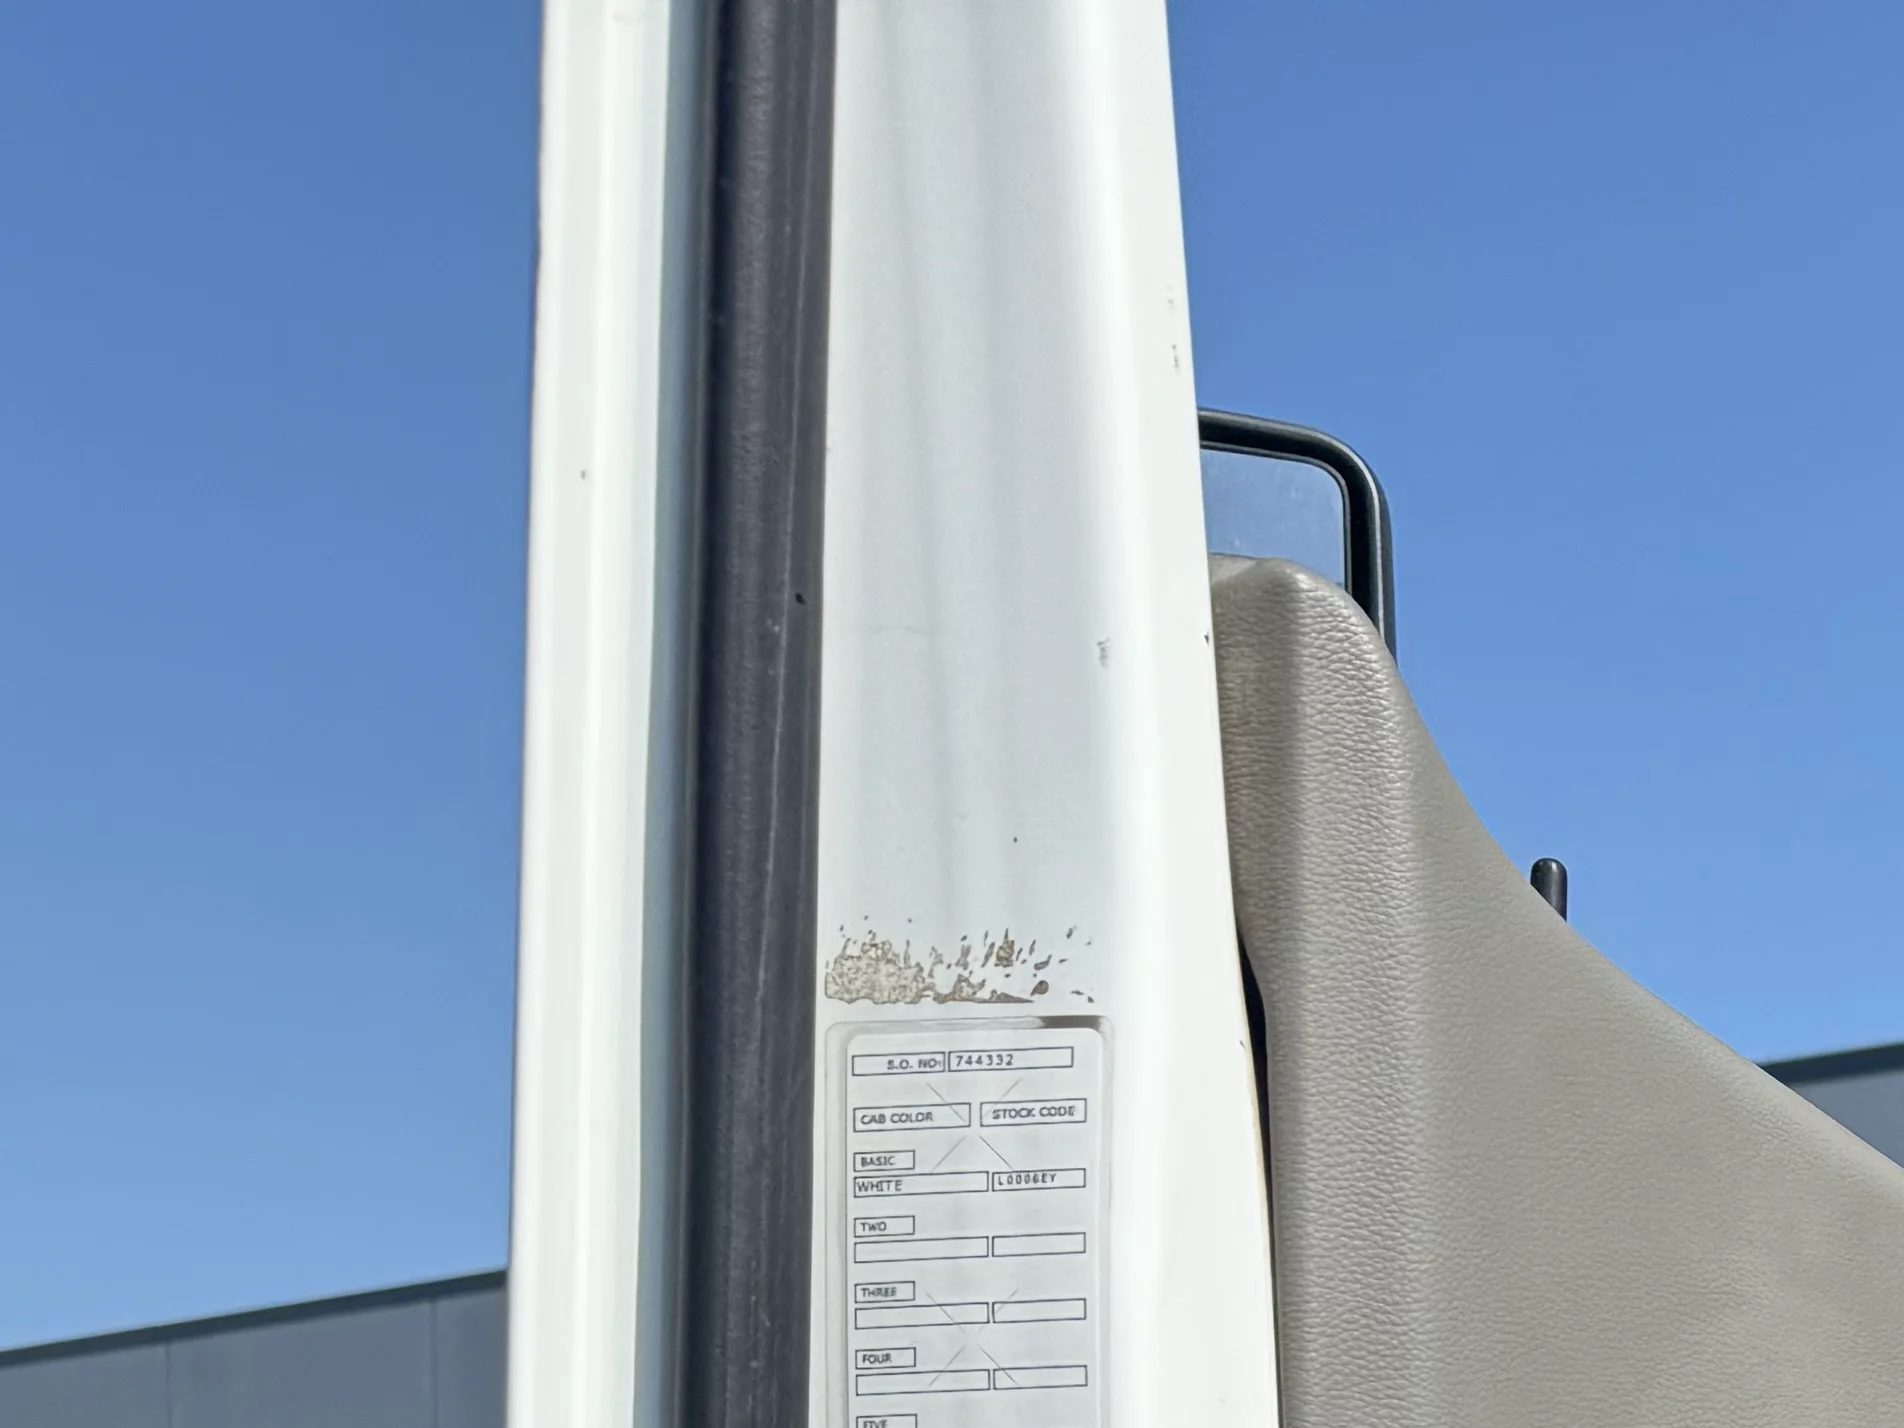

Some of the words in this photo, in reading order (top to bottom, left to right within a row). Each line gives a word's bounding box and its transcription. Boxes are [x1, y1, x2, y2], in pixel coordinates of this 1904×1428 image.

[955, 1053, 1014, 1067] 744332
[860, 1114, 886, 1125] CAB
[890, 1112, 934, 1124] COLOR
[992, 1107, 1036, 1120] STOCK
[1039, 1105, 1075, 1118] CODE
[861, 1155, 896, 1168] BASIC
[857, 1179, 903, 1192] WHITE
[861, 1221, 887, 1232] TWO
[861, 1287, 897, 1299] THREE
[862, 1353, 892, 1365] FOUR
